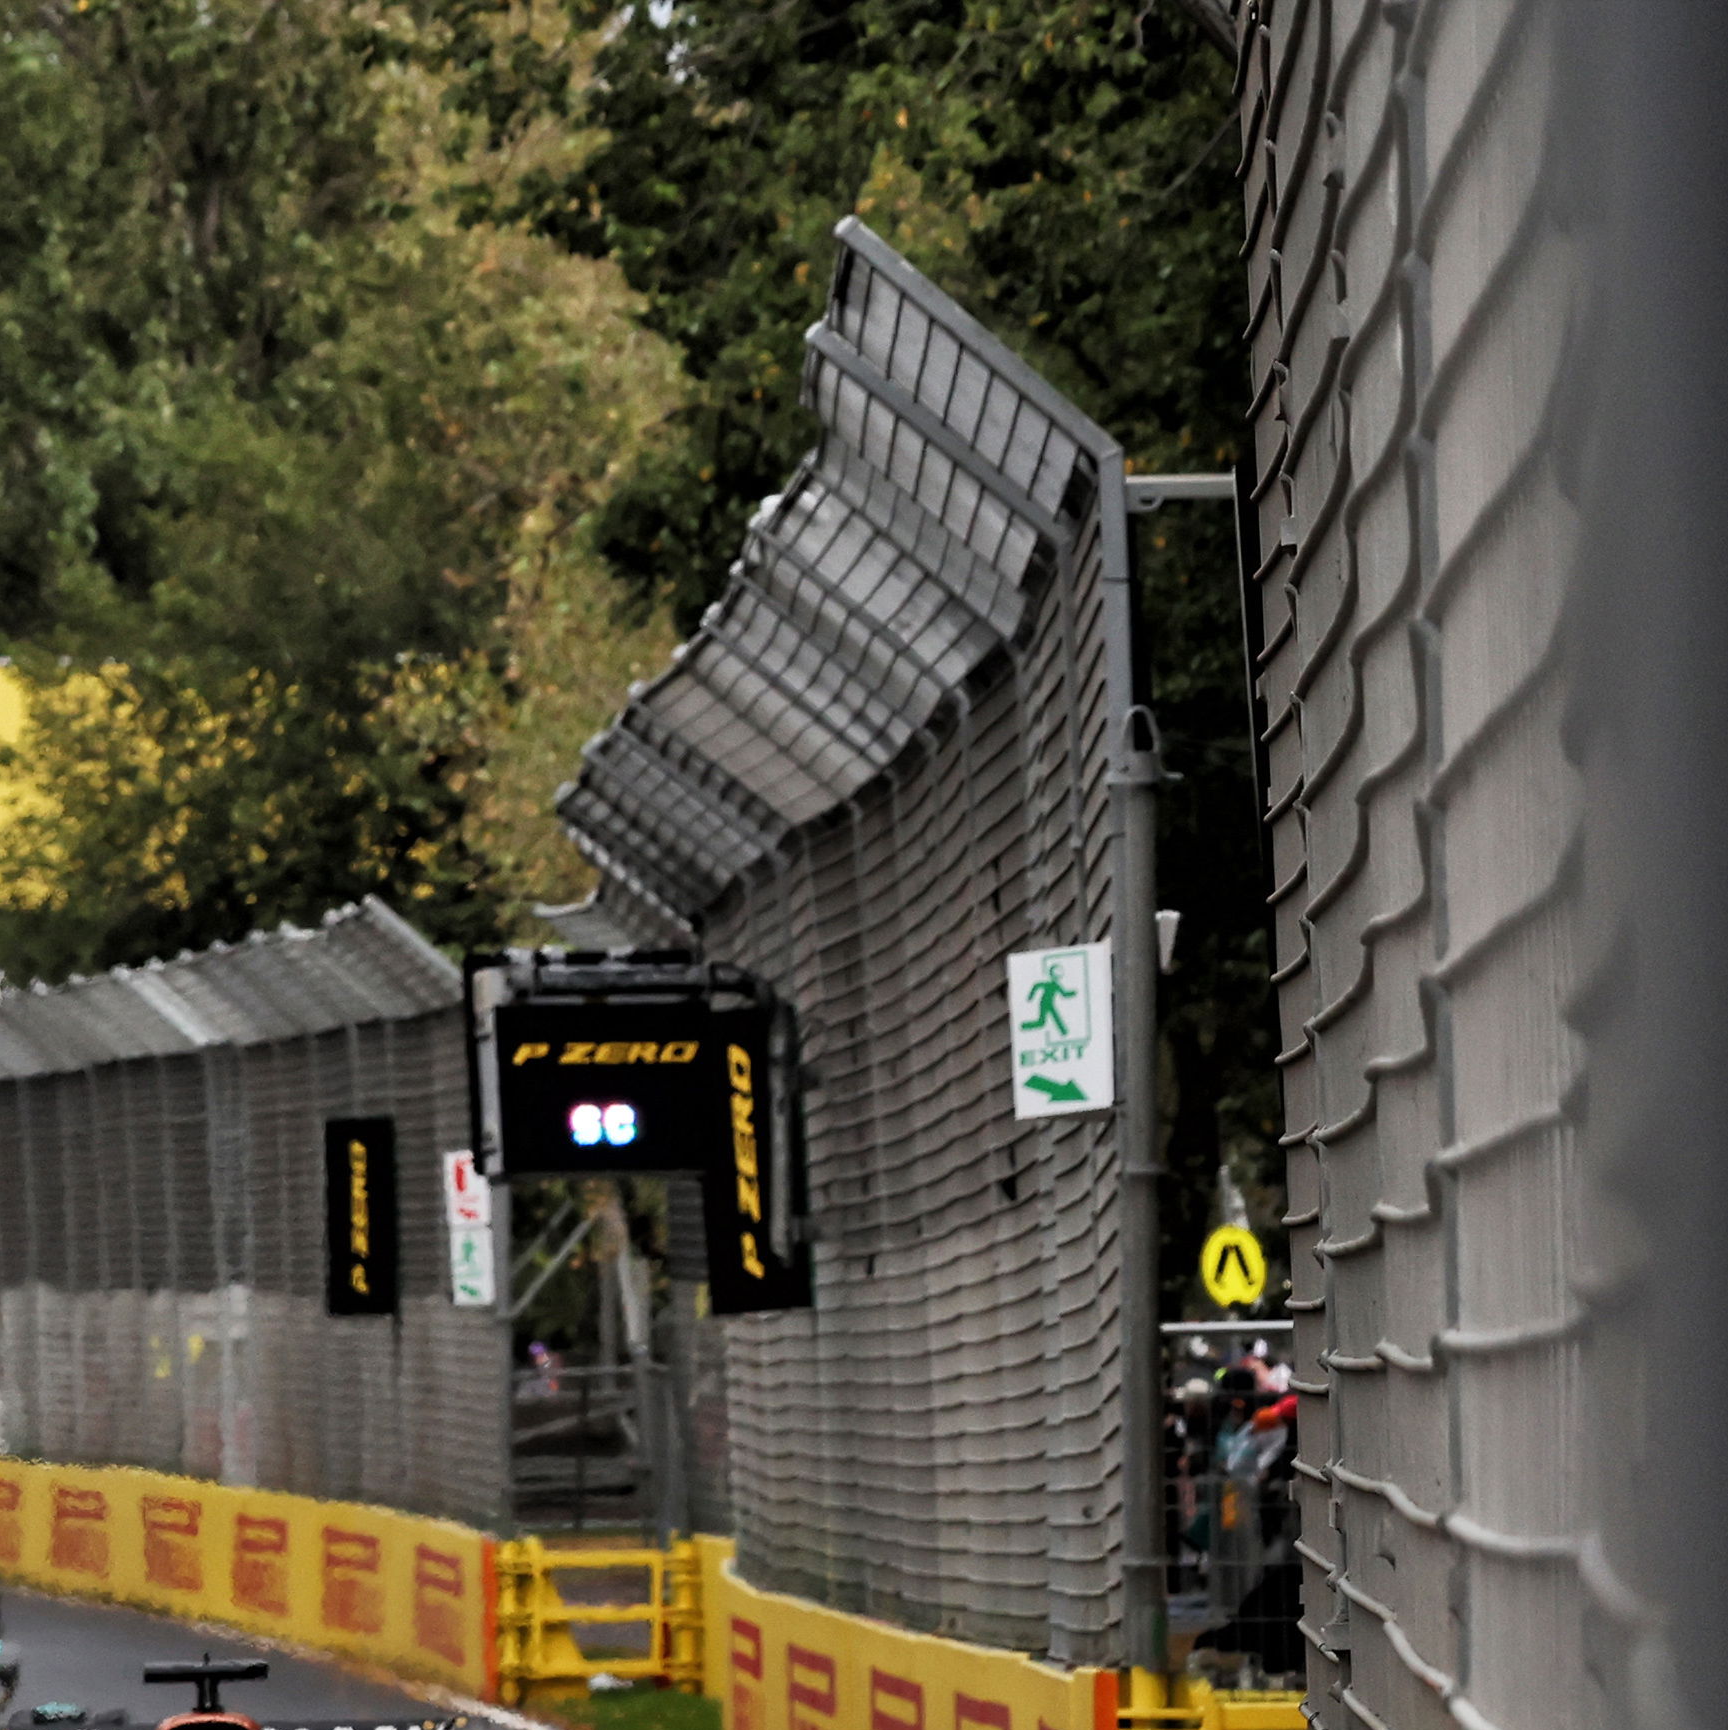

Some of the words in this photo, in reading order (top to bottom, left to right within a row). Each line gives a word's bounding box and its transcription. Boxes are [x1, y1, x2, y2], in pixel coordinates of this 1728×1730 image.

[512, 1042, 550, 1065] P
[558, 1041, 699, 1065] ZERO
[1020, 1045, 1085, 1067] EXIT
[571, 1103, 637, 1146] SC
[741, 1232, 765, 1279] P
